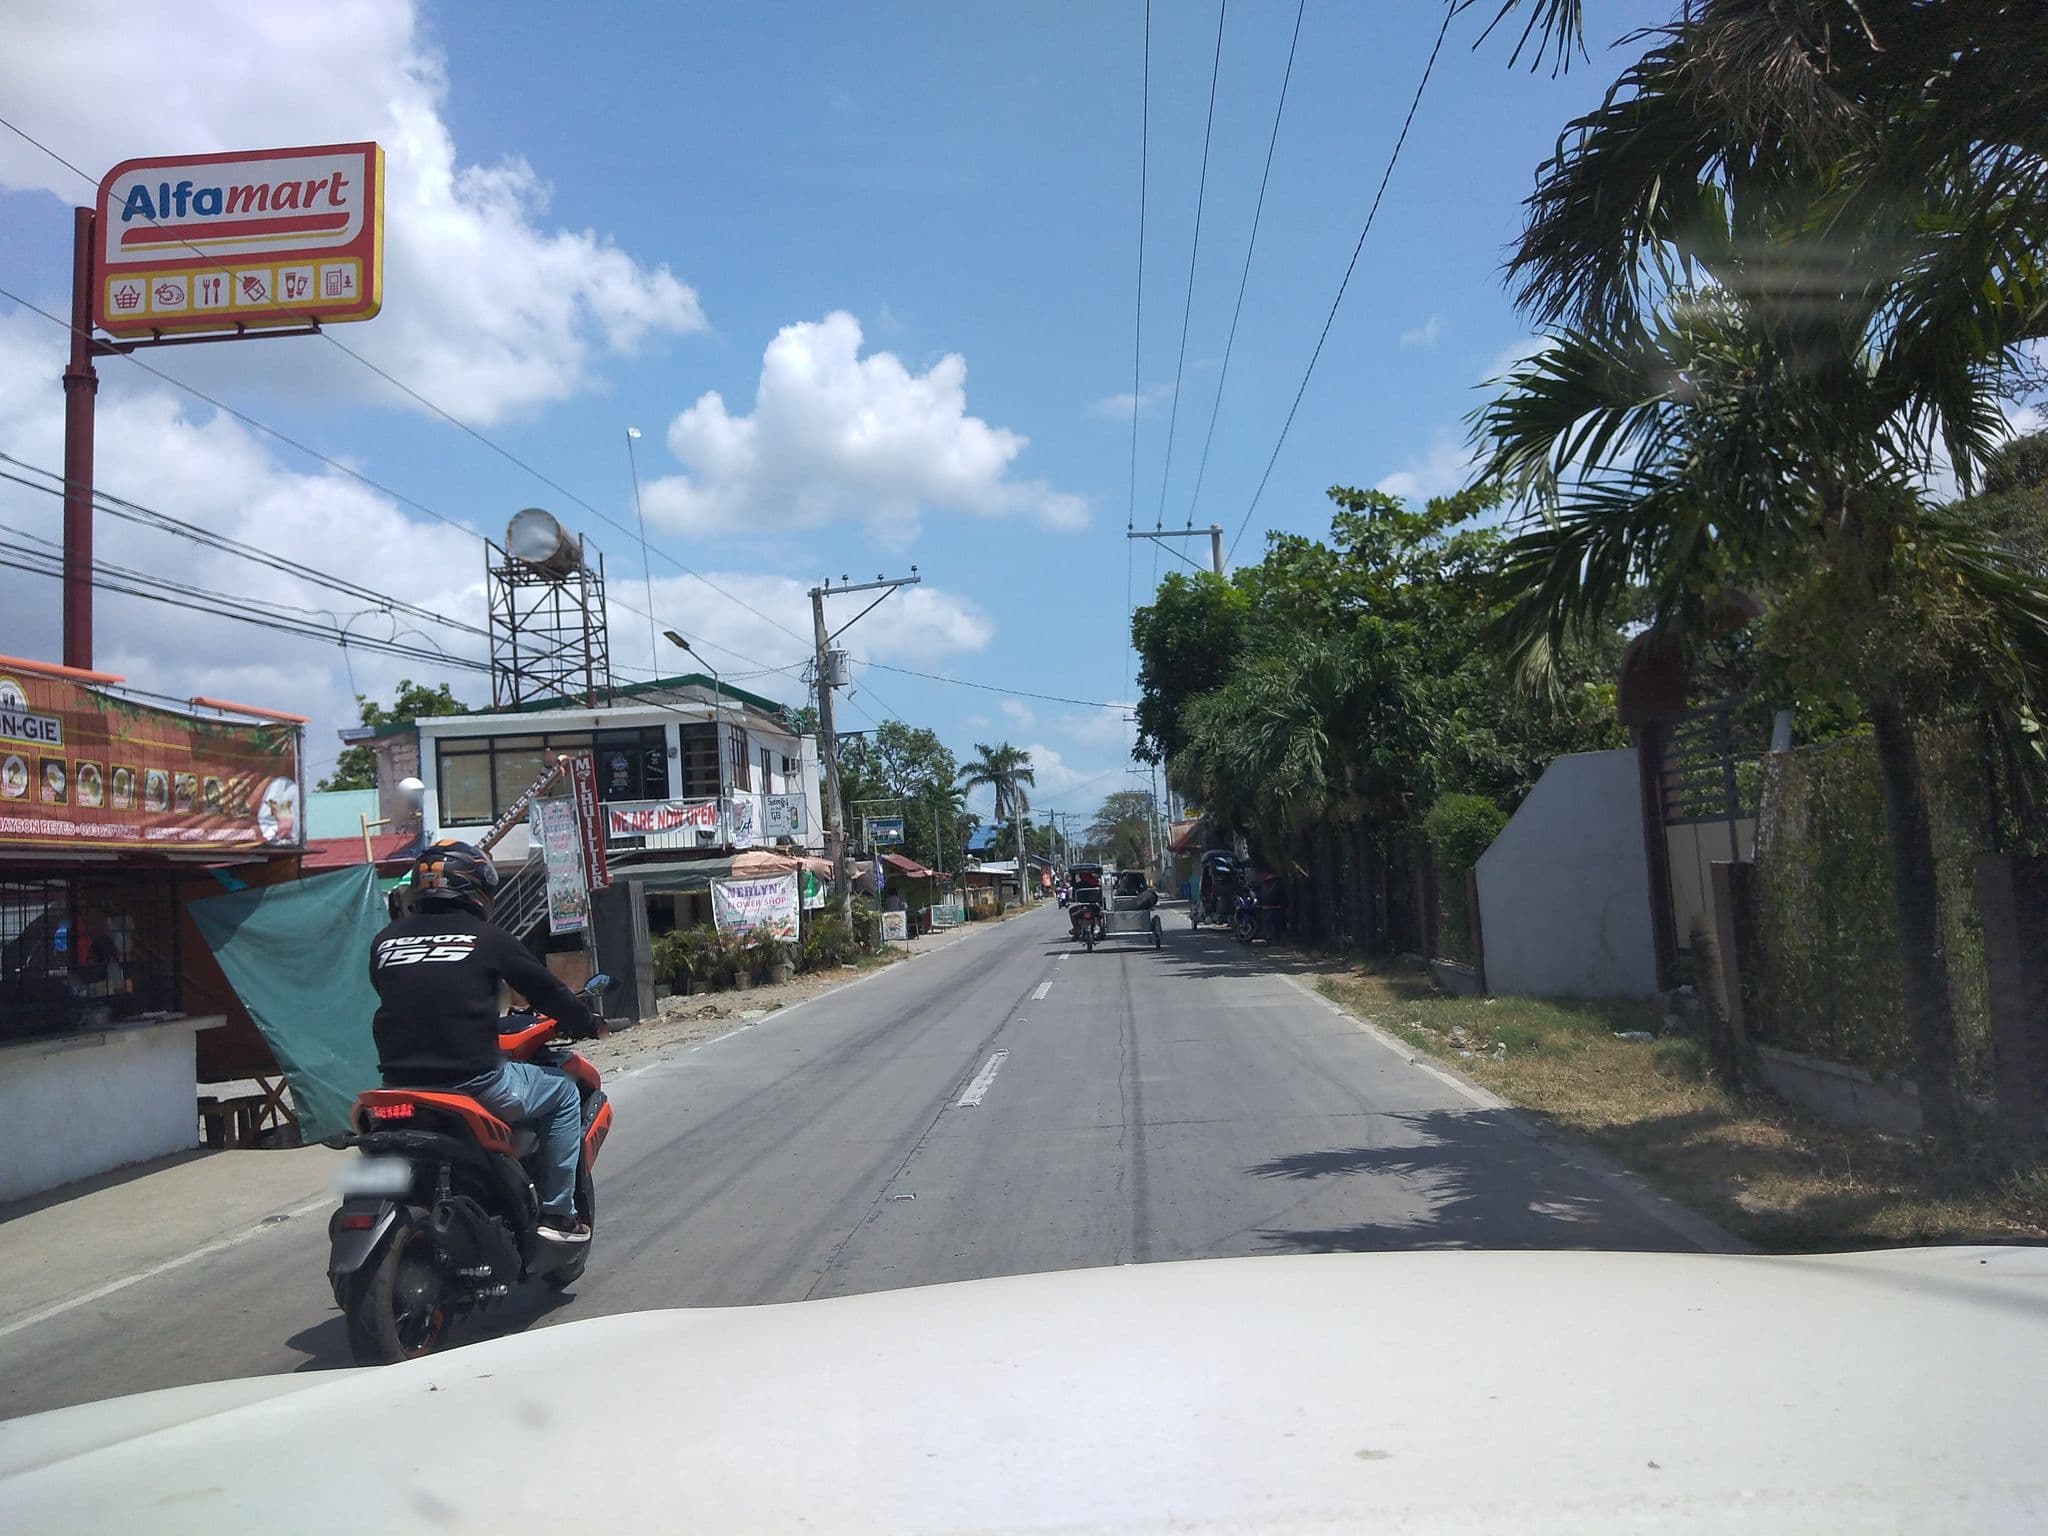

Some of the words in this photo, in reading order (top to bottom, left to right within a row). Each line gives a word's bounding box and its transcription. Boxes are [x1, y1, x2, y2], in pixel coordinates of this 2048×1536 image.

[121, 172, 350, 222] Alfamart
[0, 715, 57, 742] N-GIE
[610, 810, 628, 832] WE
[631, 810, 654, 832] ARE
[658, 808, 683, 831] NOW
[686, 802, 717, 827] OPEN
[727, 900, 761, 910] FLOWER
[764, 896, 786, 906] SHOP
[377, 946, 475, 969] 155
